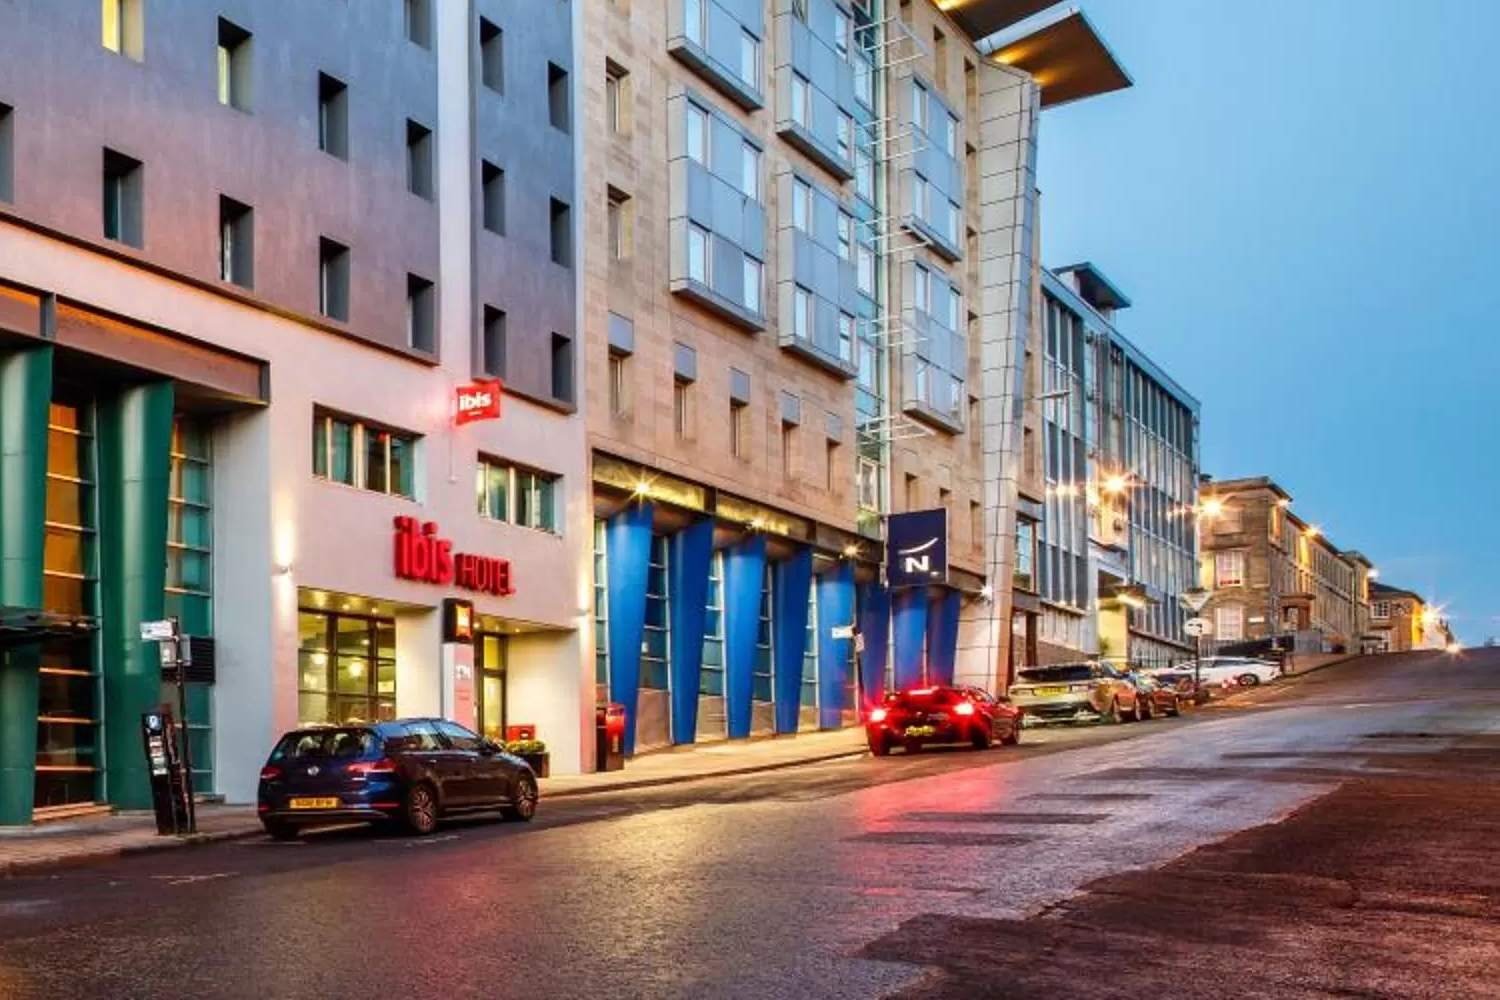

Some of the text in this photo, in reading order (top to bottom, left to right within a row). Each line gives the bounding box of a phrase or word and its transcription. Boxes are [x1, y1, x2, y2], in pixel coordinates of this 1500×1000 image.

[460, 392, 491, 411] ibis
[393, 515, 516, 597] ibis HOTEL
